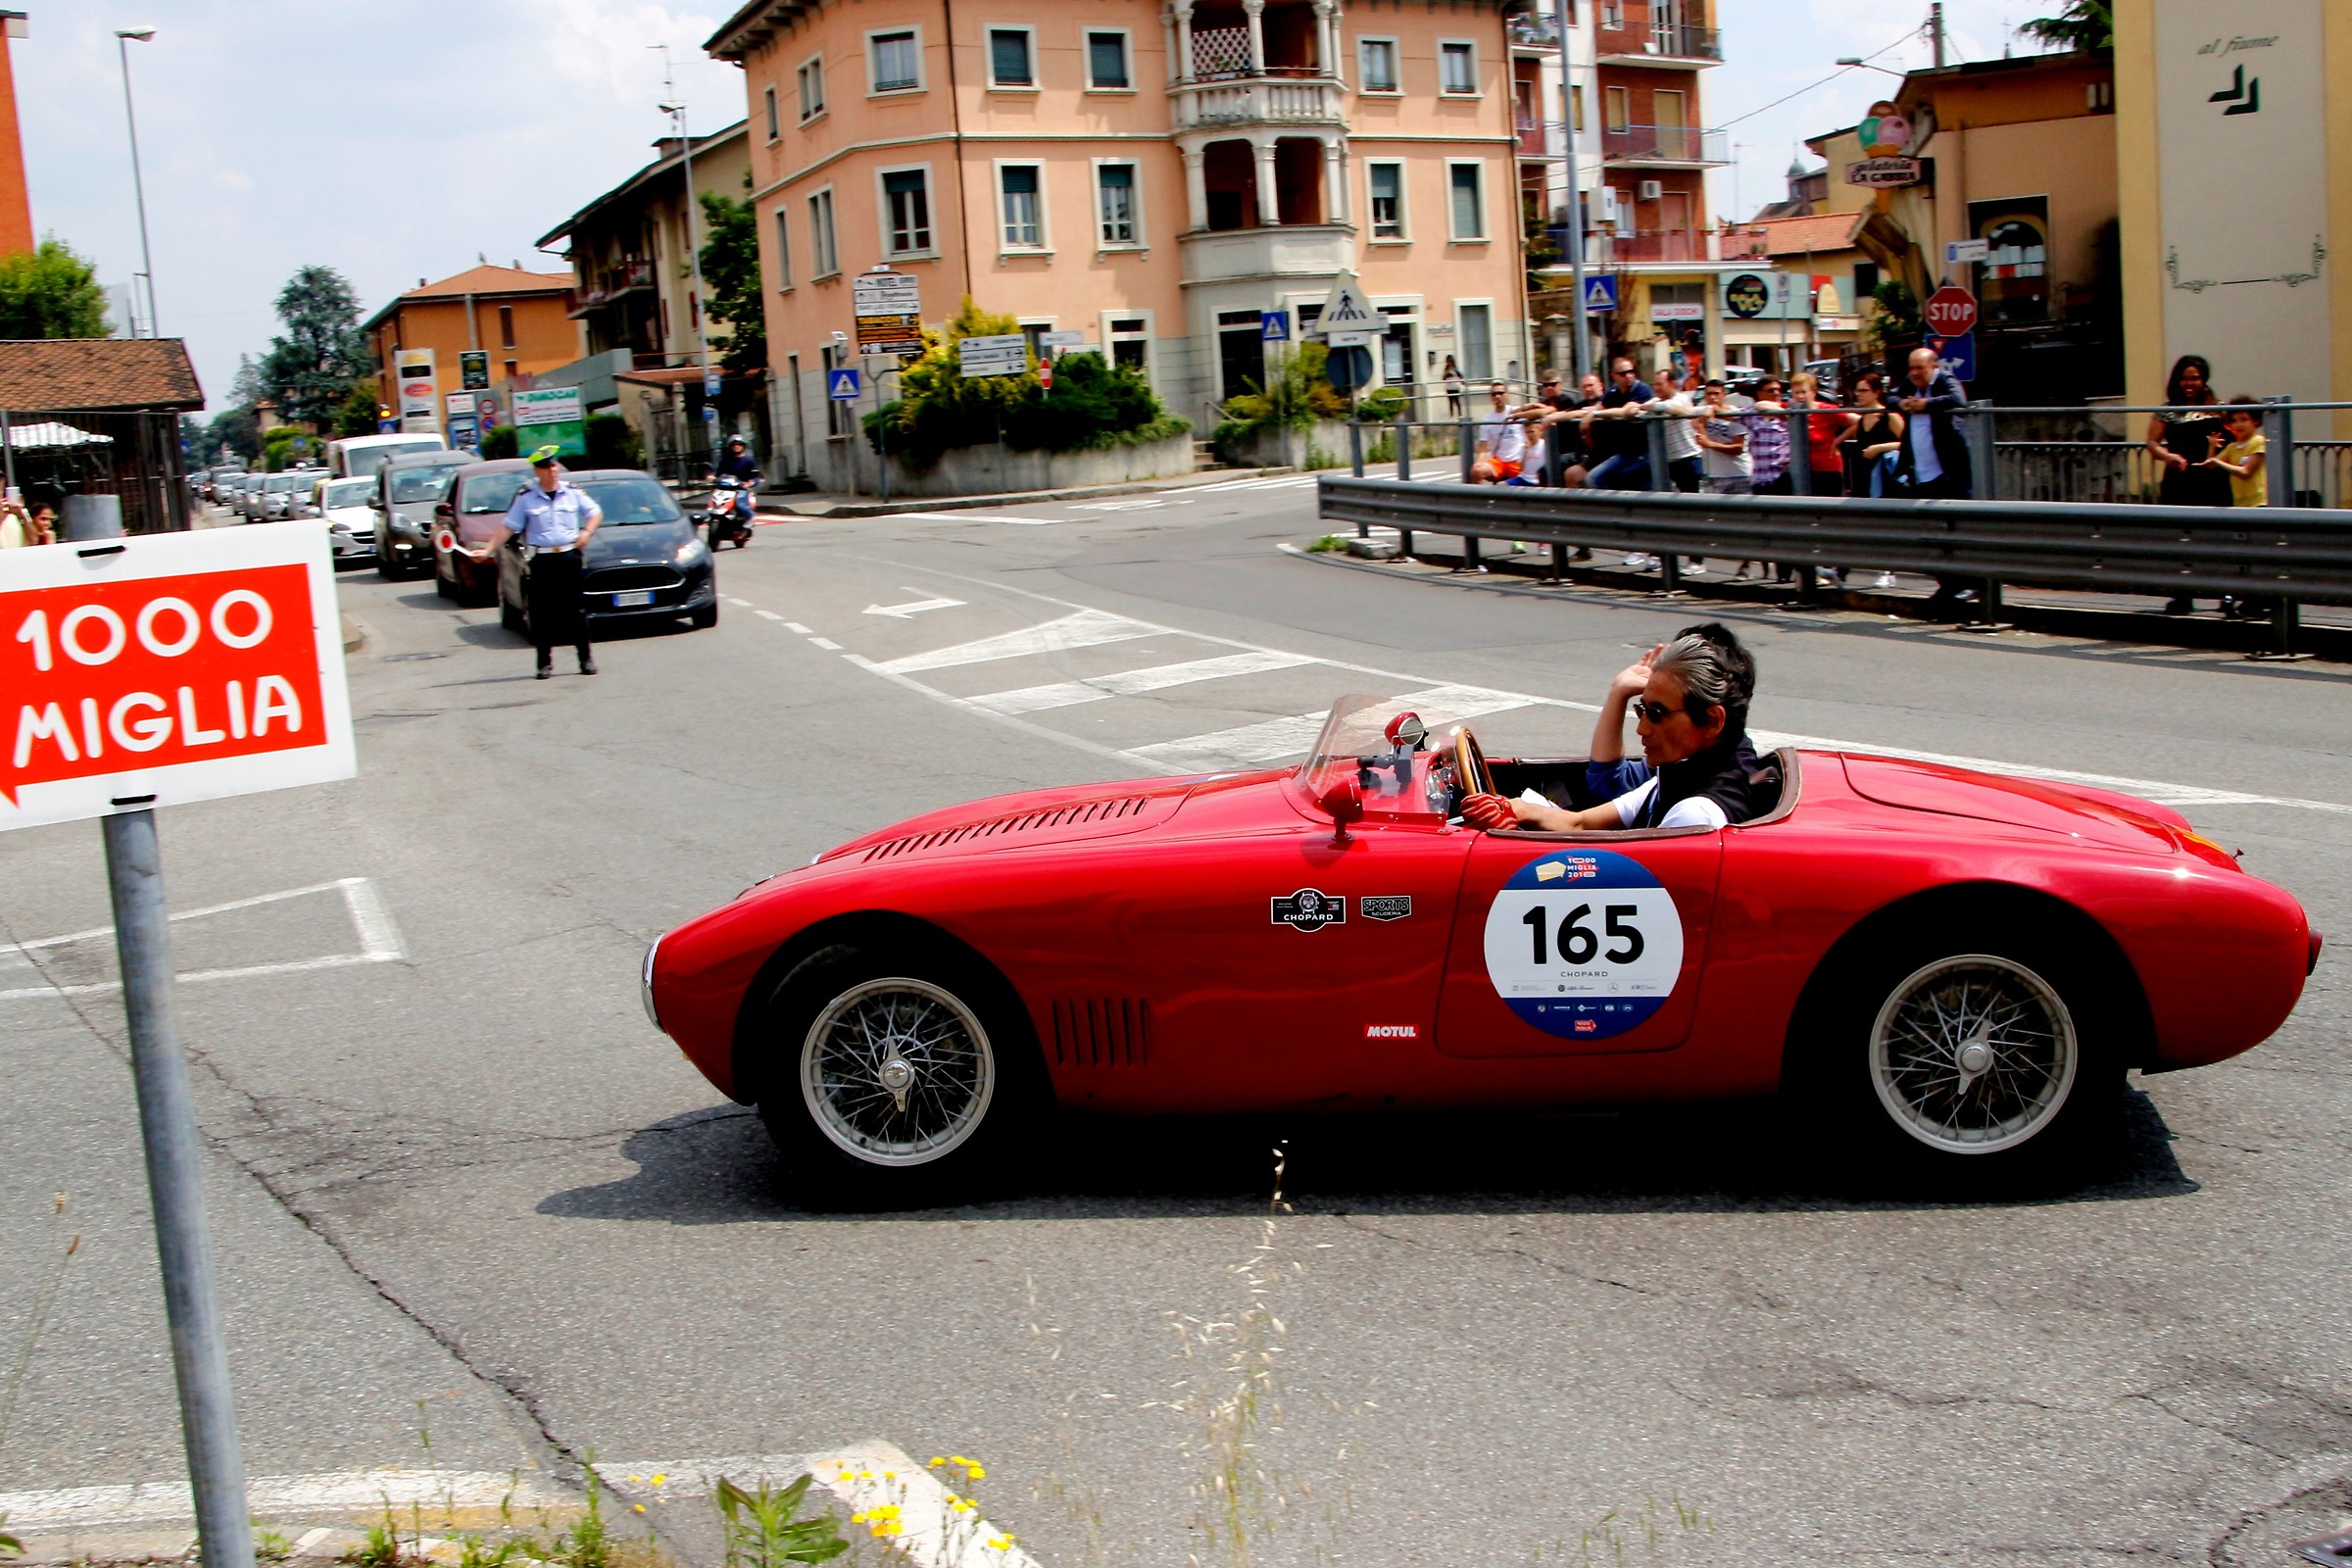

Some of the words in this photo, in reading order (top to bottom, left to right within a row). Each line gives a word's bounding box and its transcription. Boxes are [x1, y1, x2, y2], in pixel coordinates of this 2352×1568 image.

[2197, 38, 2221, 55] al
[1929, 302, 1973, 321] STOP
[16, 589, 273, 672] 1000
[13, 674, 302, 768] MIGLIA
[1363, 899, 1409, 911] SPORTS
[1523, 903, 1644, 965] 165
[1367, 1026, 1417, 1038] MOTUL
